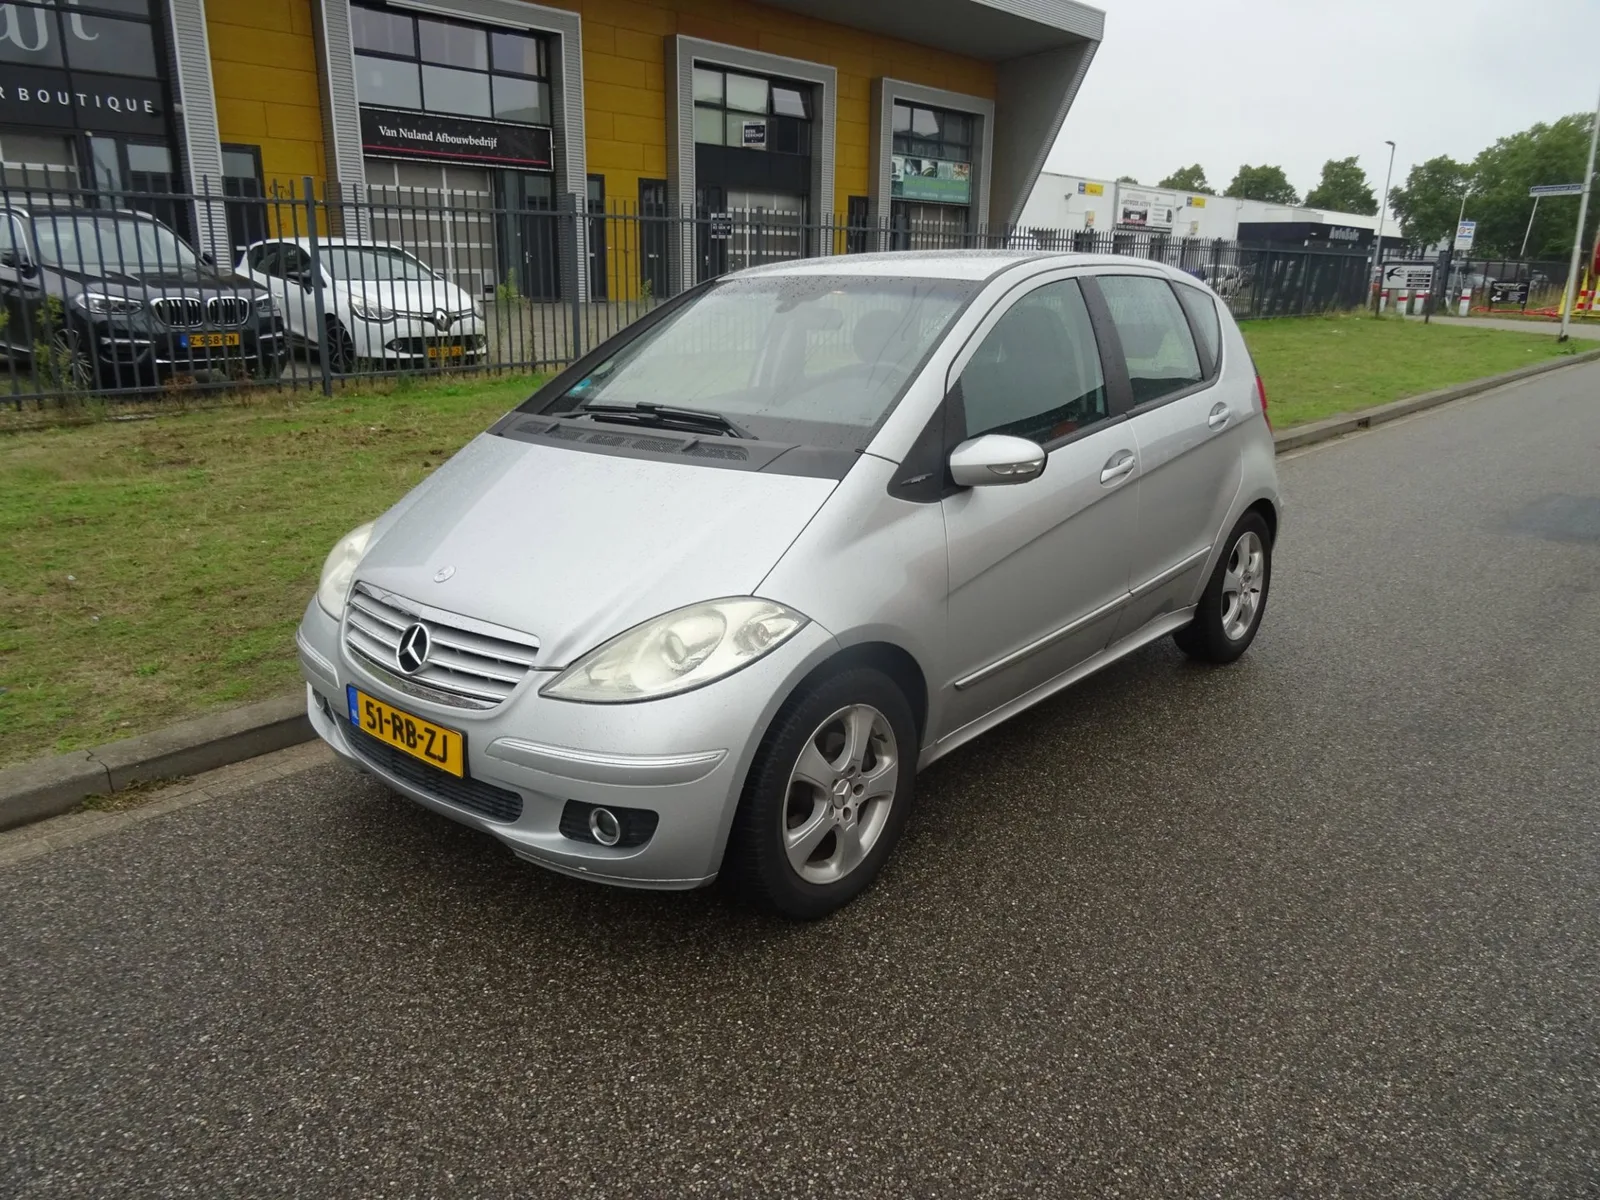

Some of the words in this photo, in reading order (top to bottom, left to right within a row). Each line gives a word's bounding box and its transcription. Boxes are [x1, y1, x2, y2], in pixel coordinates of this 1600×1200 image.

[18, 87, 154, 114] BOUTIQUE
[378, 125, 397, 138] Van
[399, 127, 433, 142] Nuland
[435, 132, 498, 150] Afbouwbedrijf
[365, 700, 448, 764] 51-RB-ZJ
